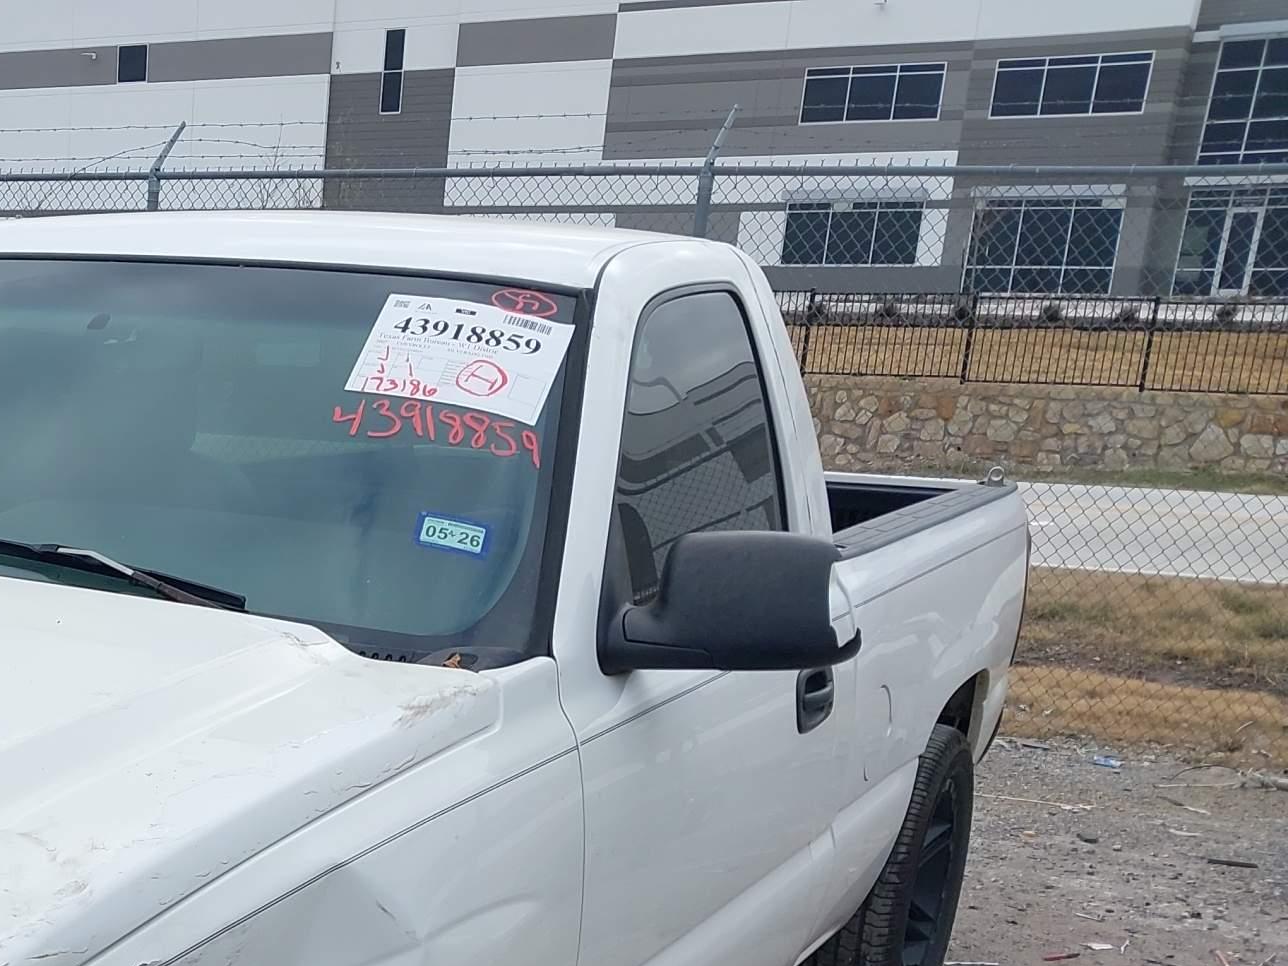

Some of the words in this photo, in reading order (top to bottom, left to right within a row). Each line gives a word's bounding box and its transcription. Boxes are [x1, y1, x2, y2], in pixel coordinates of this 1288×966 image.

[394, 316, 542, 355] 43918859
[333, 399, 541, 469] 43918859
[425, 525, 449, 540] 05
[457, 531, 481, 548] 26
